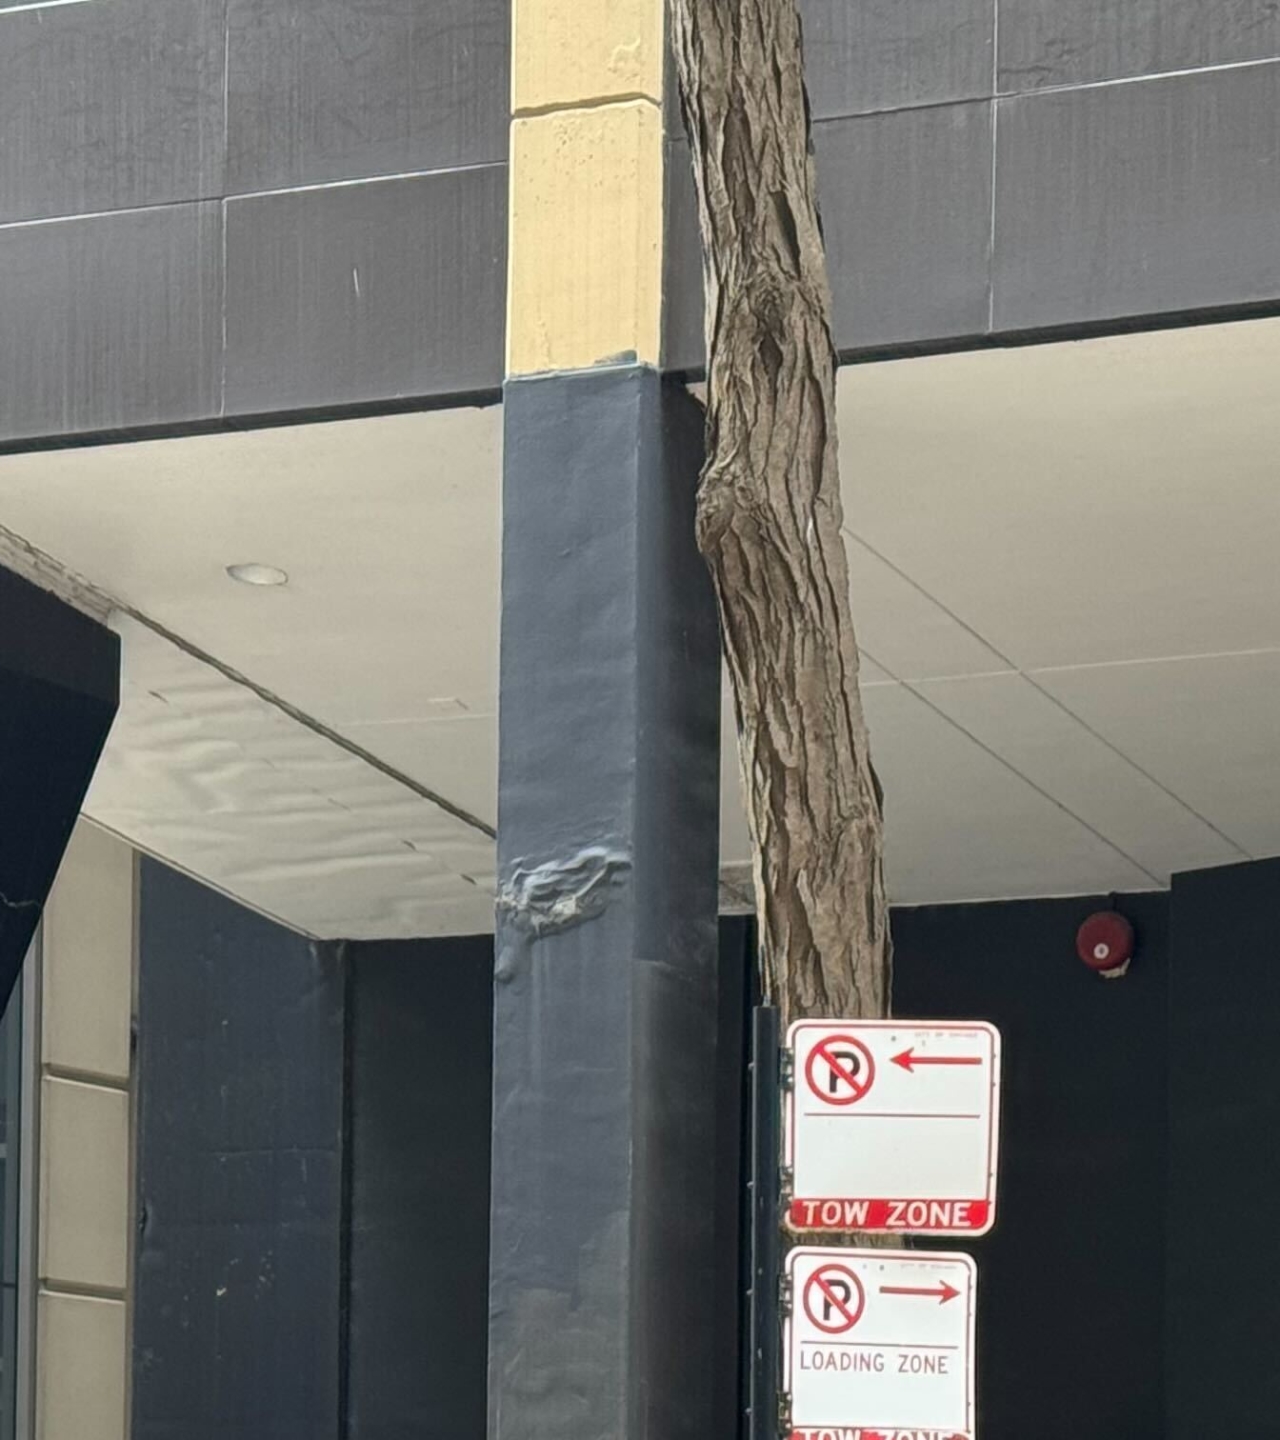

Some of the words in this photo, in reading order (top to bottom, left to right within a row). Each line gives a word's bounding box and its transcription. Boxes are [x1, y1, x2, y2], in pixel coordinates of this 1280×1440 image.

[802, 1201, 868, 1226] TOW
[885, 1201, 972, 1228] ZONE
[799, 1350, 885, 1373] LOADING
[897, 1354, 949, 1375] ZONE
